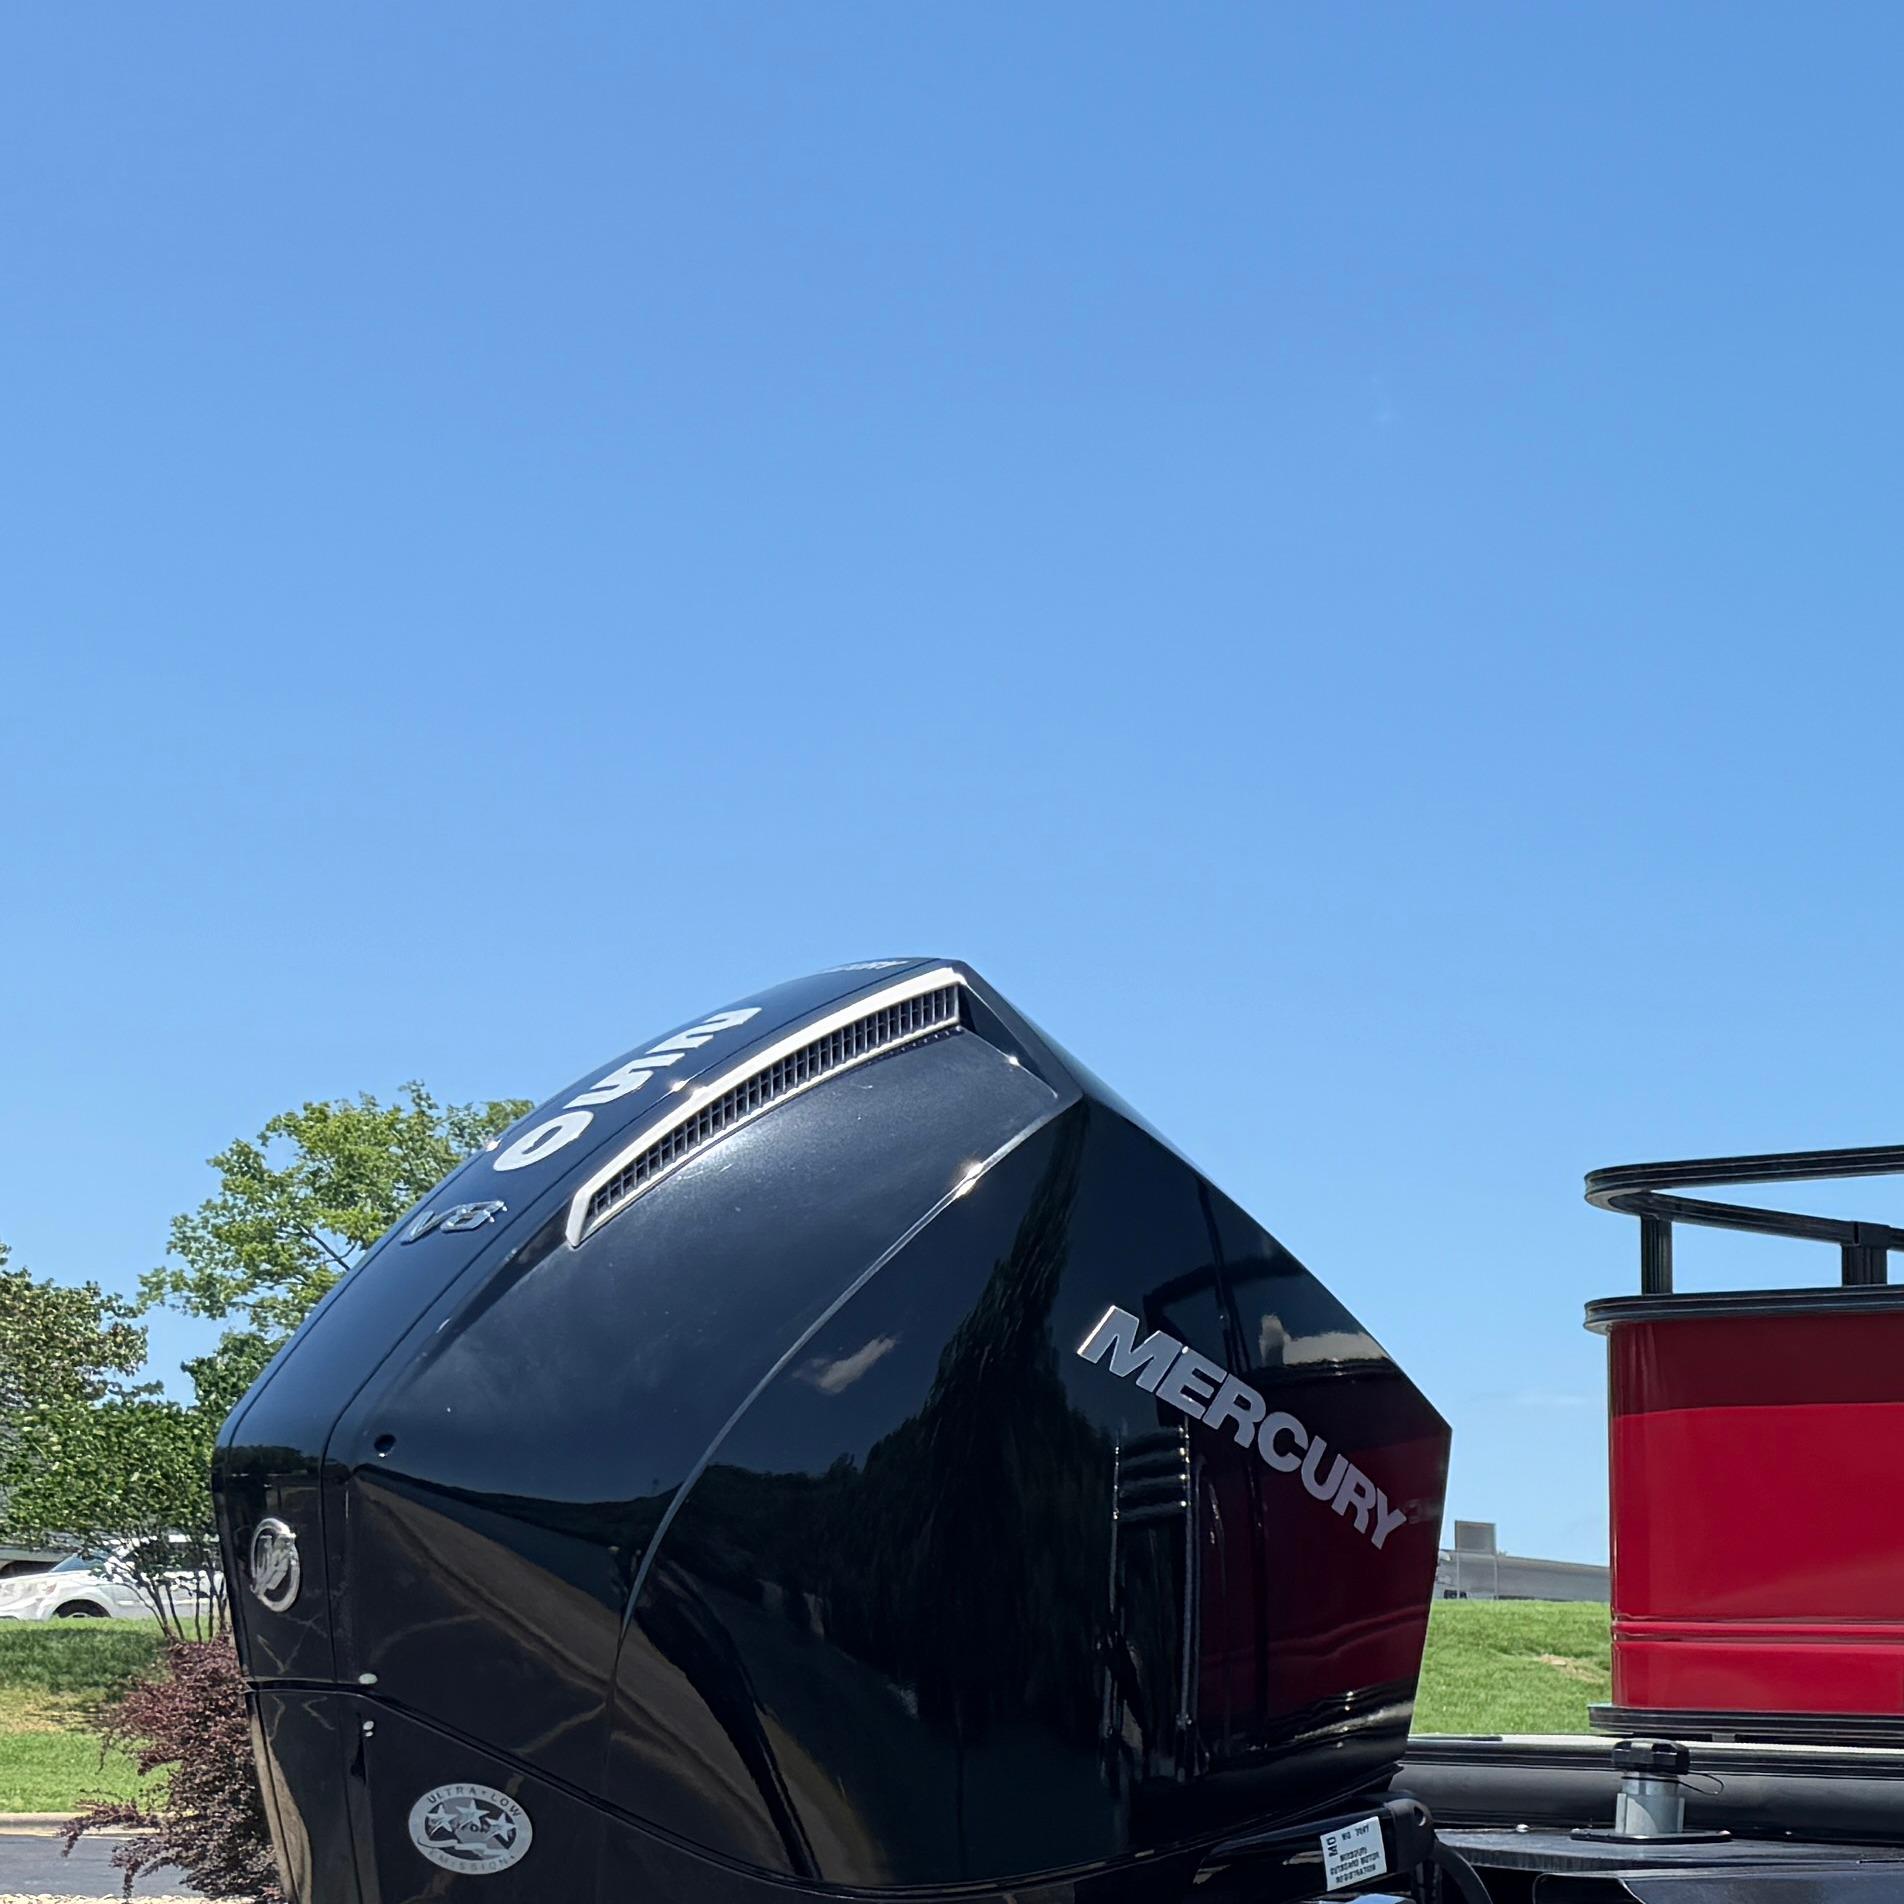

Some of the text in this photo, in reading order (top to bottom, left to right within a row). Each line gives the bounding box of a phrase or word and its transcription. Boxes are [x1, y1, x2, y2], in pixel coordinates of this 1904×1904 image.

[400, 1199, 508, 1246] V8
[1076, 1304, 1408, 1551] MERCURY
[426, 1785, 522, 1818] ULTRA LOW
